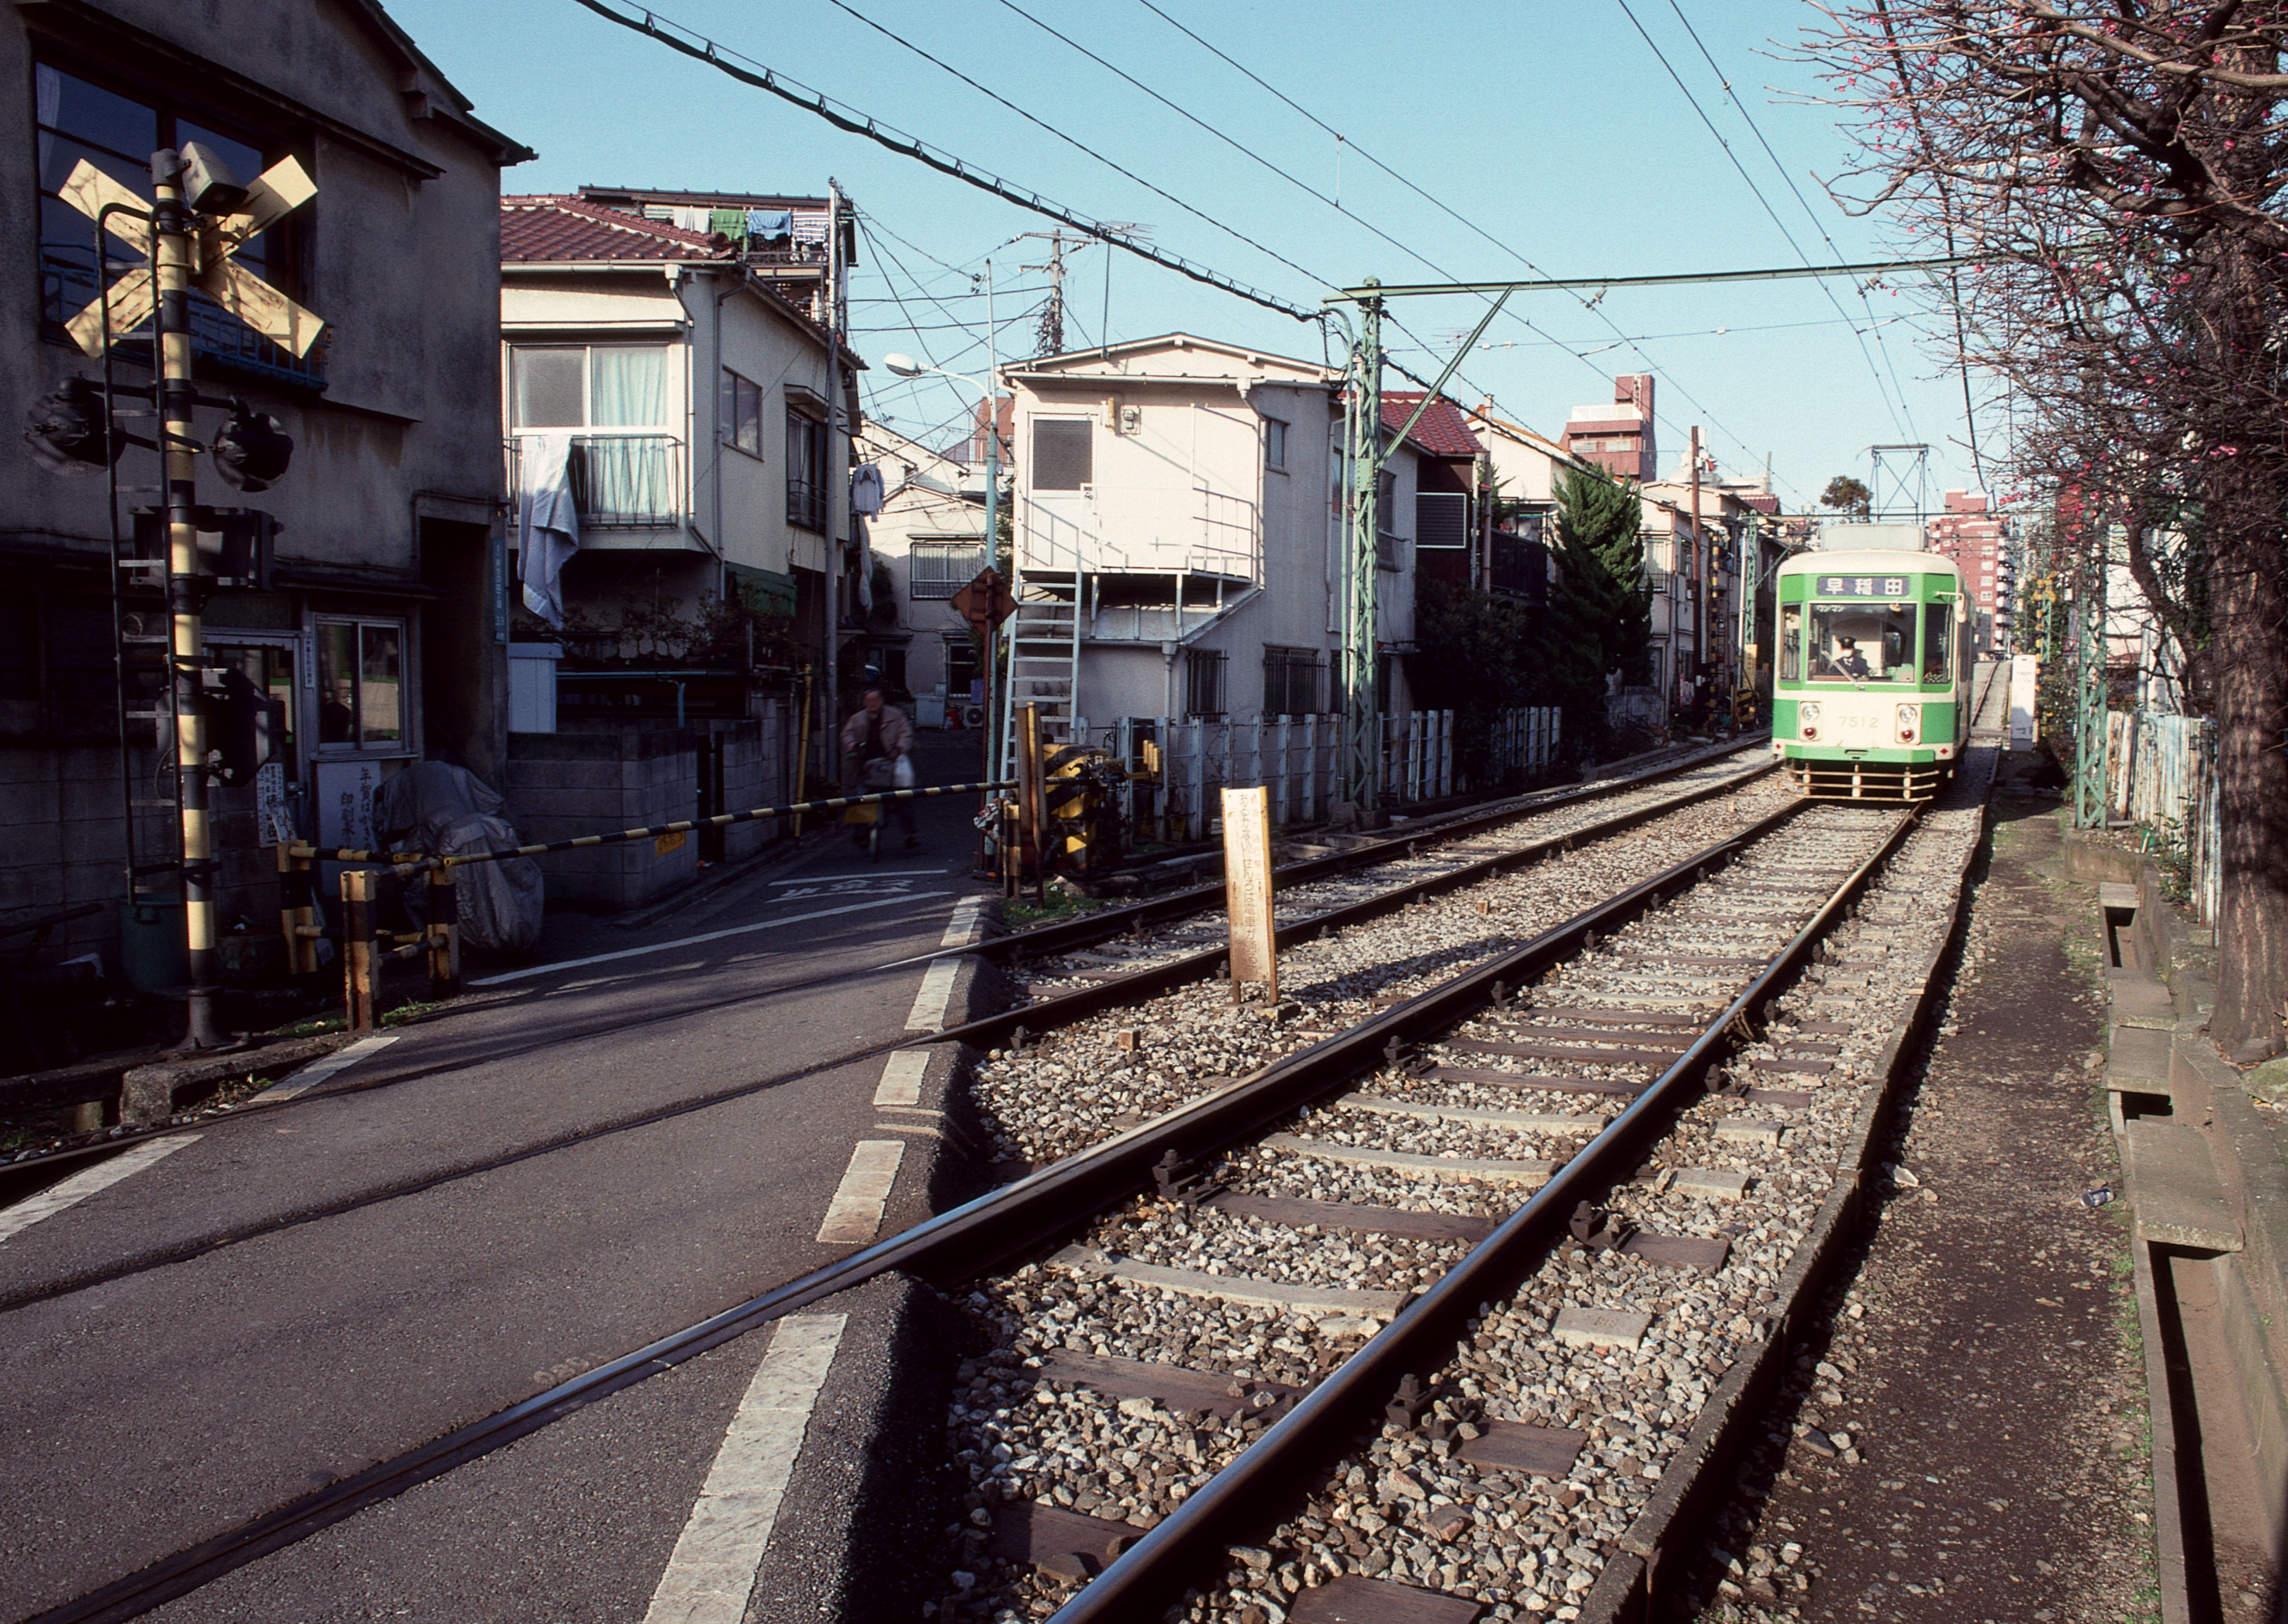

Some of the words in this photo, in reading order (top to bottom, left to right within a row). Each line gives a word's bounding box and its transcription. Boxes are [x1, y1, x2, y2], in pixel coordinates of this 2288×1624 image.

[1825, 577, 1903, 595] 早稲田
[1837, 716, 1879, 728] 7512
